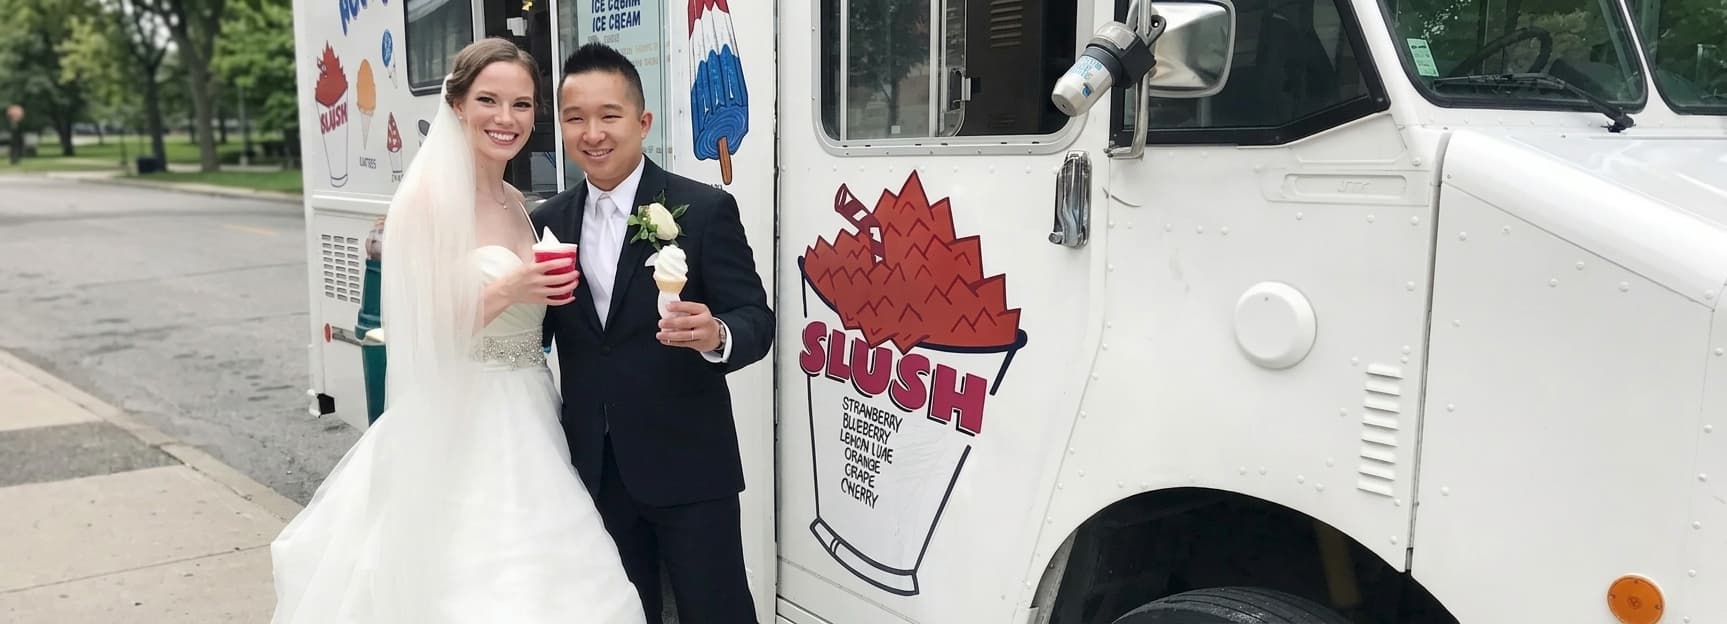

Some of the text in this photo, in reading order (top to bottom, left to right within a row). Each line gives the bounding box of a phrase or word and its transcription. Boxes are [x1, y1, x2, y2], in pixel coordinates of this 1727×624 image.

[592, 10, 641, 32] ICE CREAM
[320, 101, 348, 135] SLUSH
[799, 320, 988, 437] SLUSH
[844, 447, 881, 474] ORANGE
